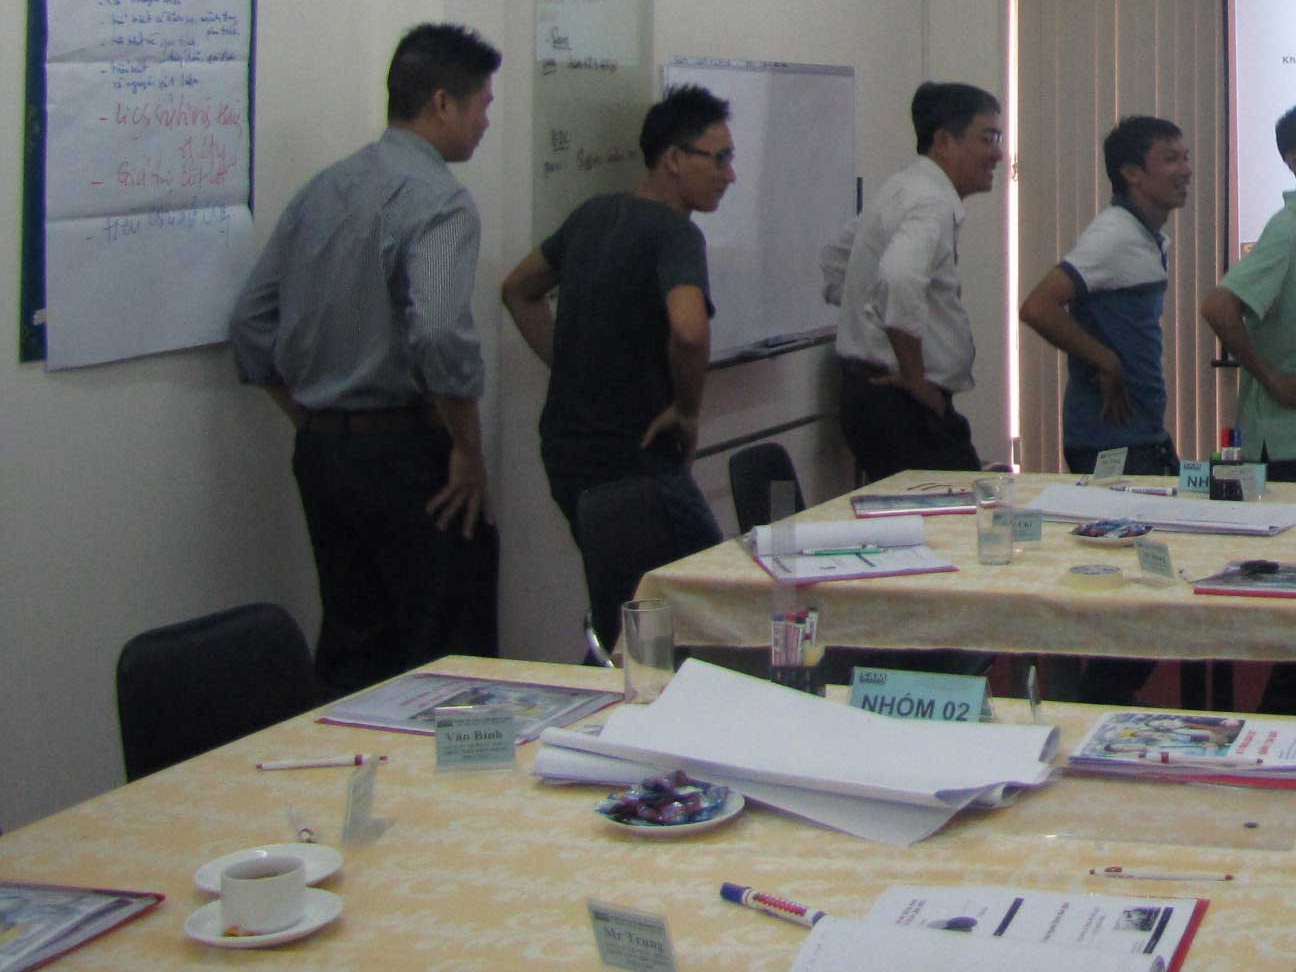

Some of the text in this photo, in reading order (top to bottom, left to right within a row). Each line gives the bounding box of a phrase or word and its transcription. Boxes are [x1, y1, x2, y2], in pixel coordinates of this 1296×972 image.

[1187, 475, 1209, 488] NH
[861, 692, 970, 721] NHÓM 02
